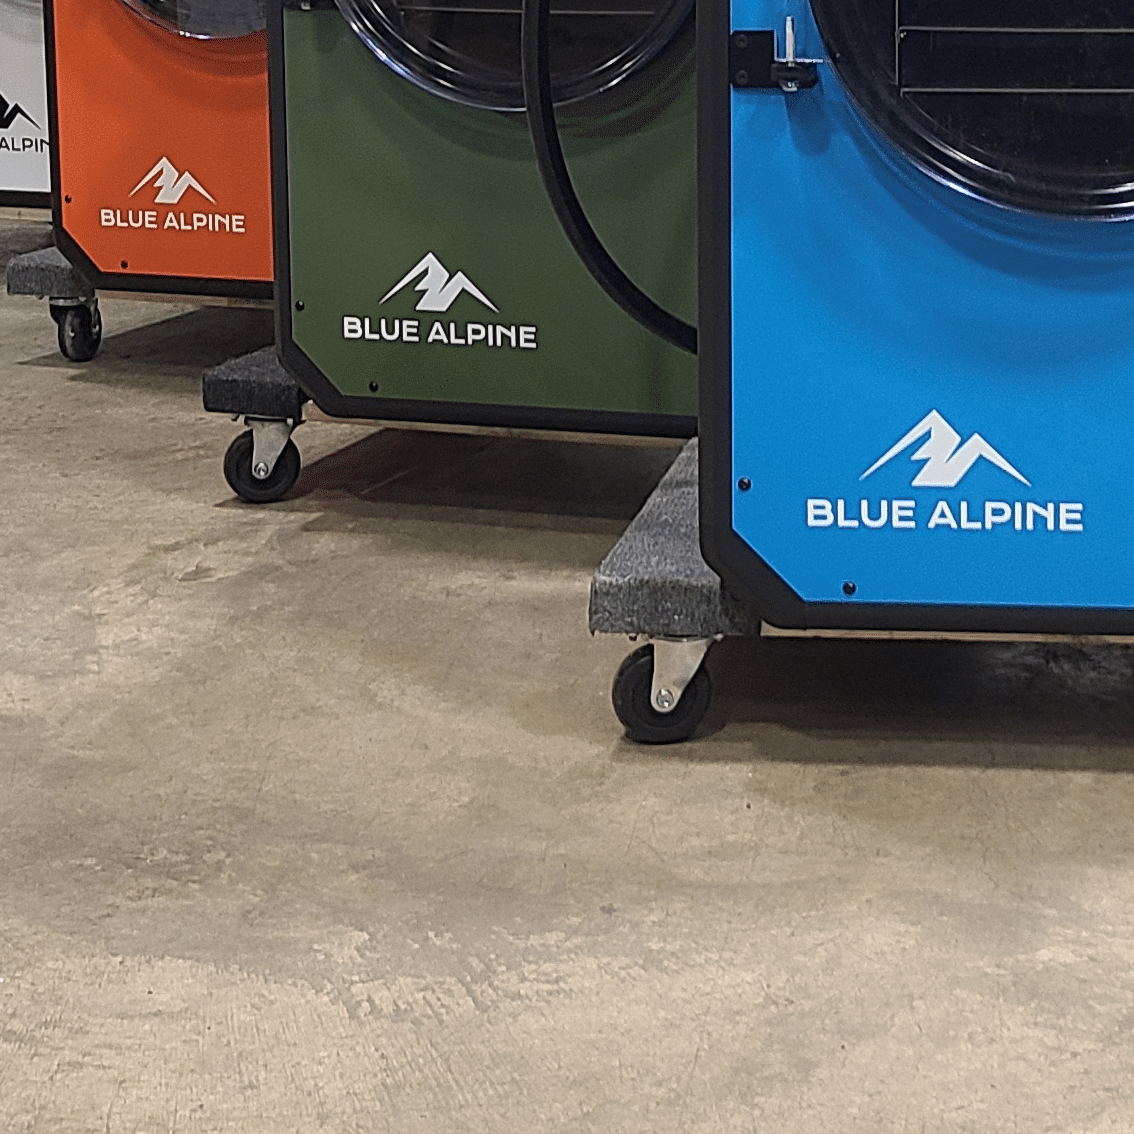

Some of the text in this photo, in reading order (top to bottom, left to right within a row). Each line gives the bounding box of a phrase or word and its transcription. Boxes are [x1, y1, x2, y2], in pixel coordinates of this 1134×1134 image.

[0, 136, 49, 153] ALPIN
[100, 208, 246, 233] BLUE ALPINE
[343, 316, 537, 349] BLUE ALPINE
[806, 498, 1084, 532] BLUE ALPINE
